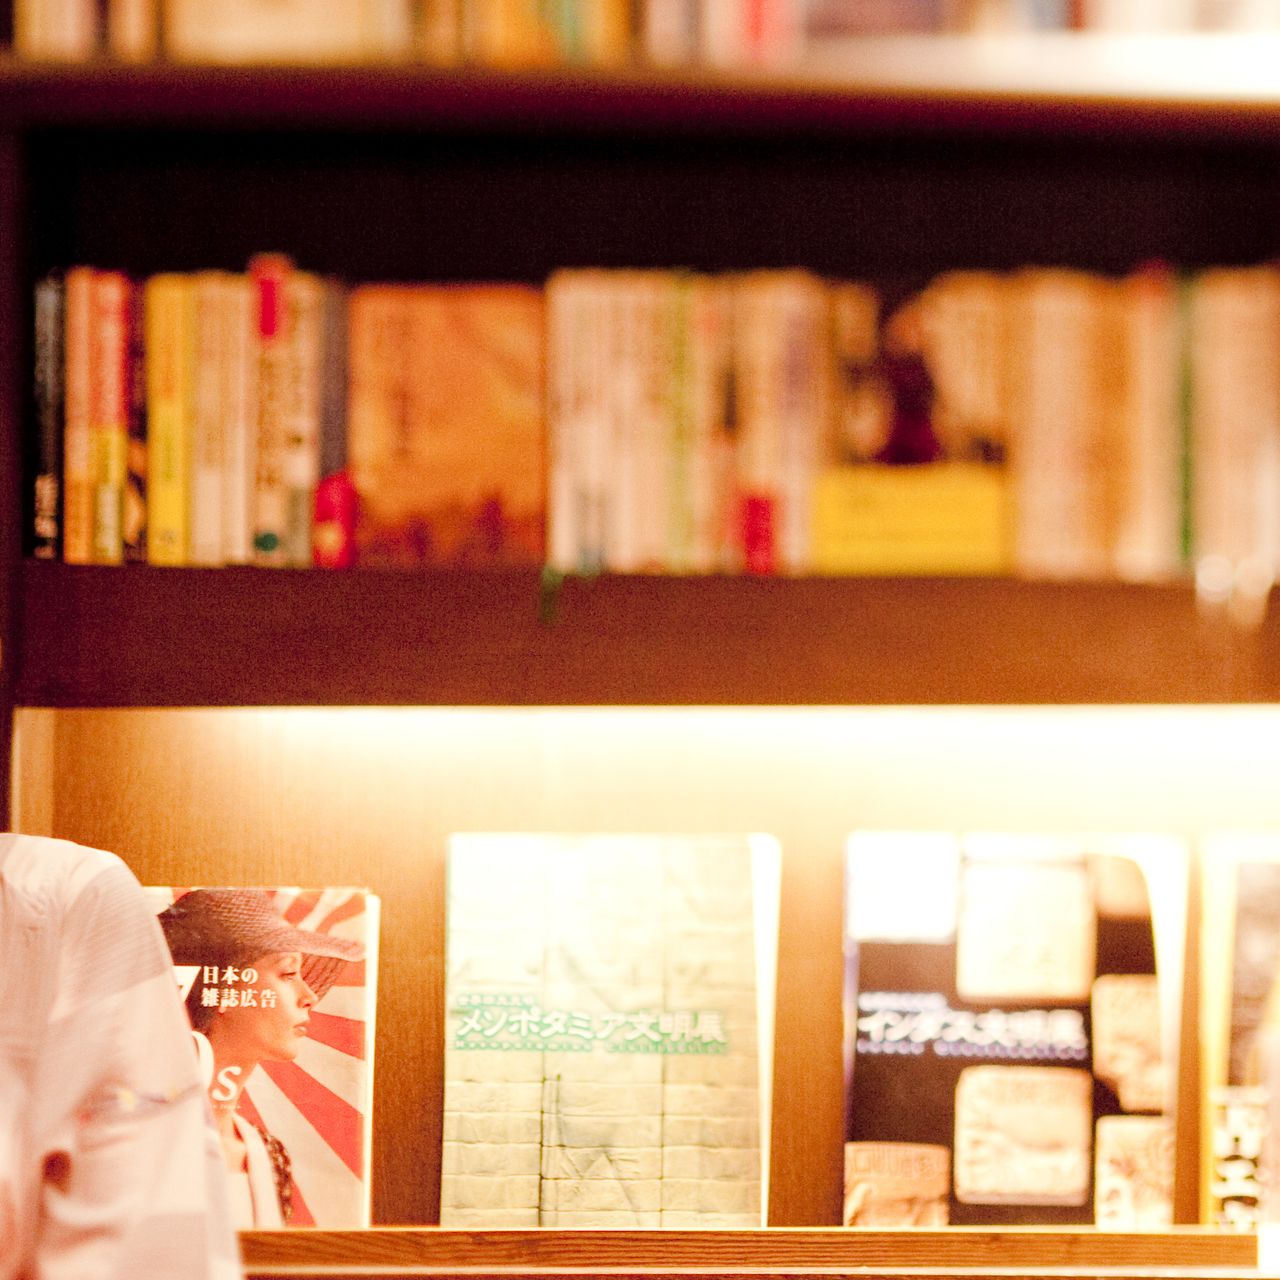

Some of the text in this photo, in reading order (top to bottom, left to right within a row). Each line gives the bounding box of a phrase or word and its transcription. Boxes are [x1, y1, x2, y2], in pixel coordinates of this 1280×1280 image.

[203, 965, 259, 985] 日本の
[201, 987, 277, 1009] 雑誌広告
